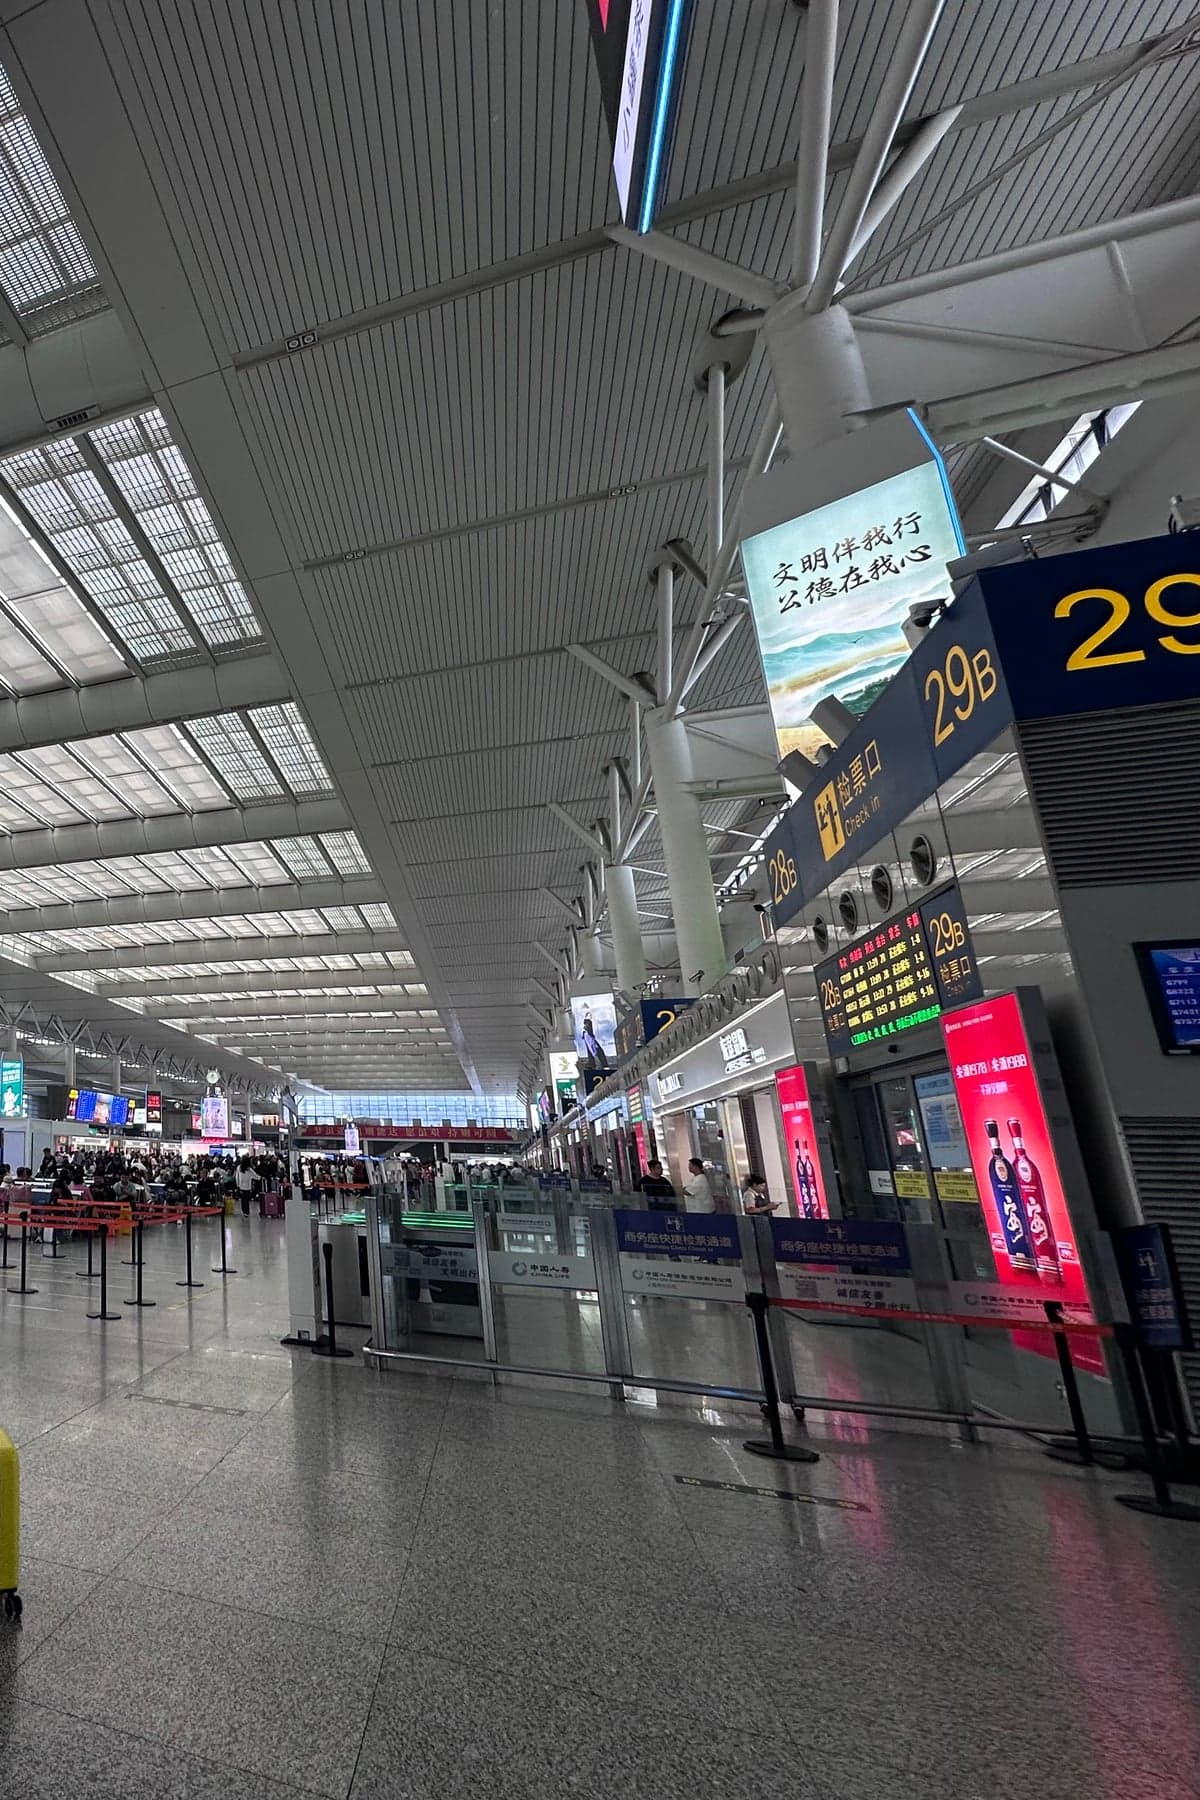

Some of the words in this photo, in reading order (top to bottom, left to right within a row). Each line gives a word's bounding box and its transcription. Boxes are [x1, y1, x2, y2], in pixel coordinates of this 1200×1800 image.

[773, 511, 923, 588] 文明伴我行
[779, 544, 933, 615] 公德在我心
[924, 644, 998, 747] 29B
[836, 738, 882, 808] 检票口
[845, 812, 870, 838] Check
[871, 796, 881, 812] in
[769, 848, 798, 905] 28B
[910, 932, 921, 947] 1-8
[929, 912, 965, 958] 29B
[913, 950, 925, 964] 1-8
[916, 966, 931, 982] 9-16
[939, 955, 972, 984] 检票口
[820, 978, 842, 1011] 28B
[920, 983, 935, 999] 9-16
